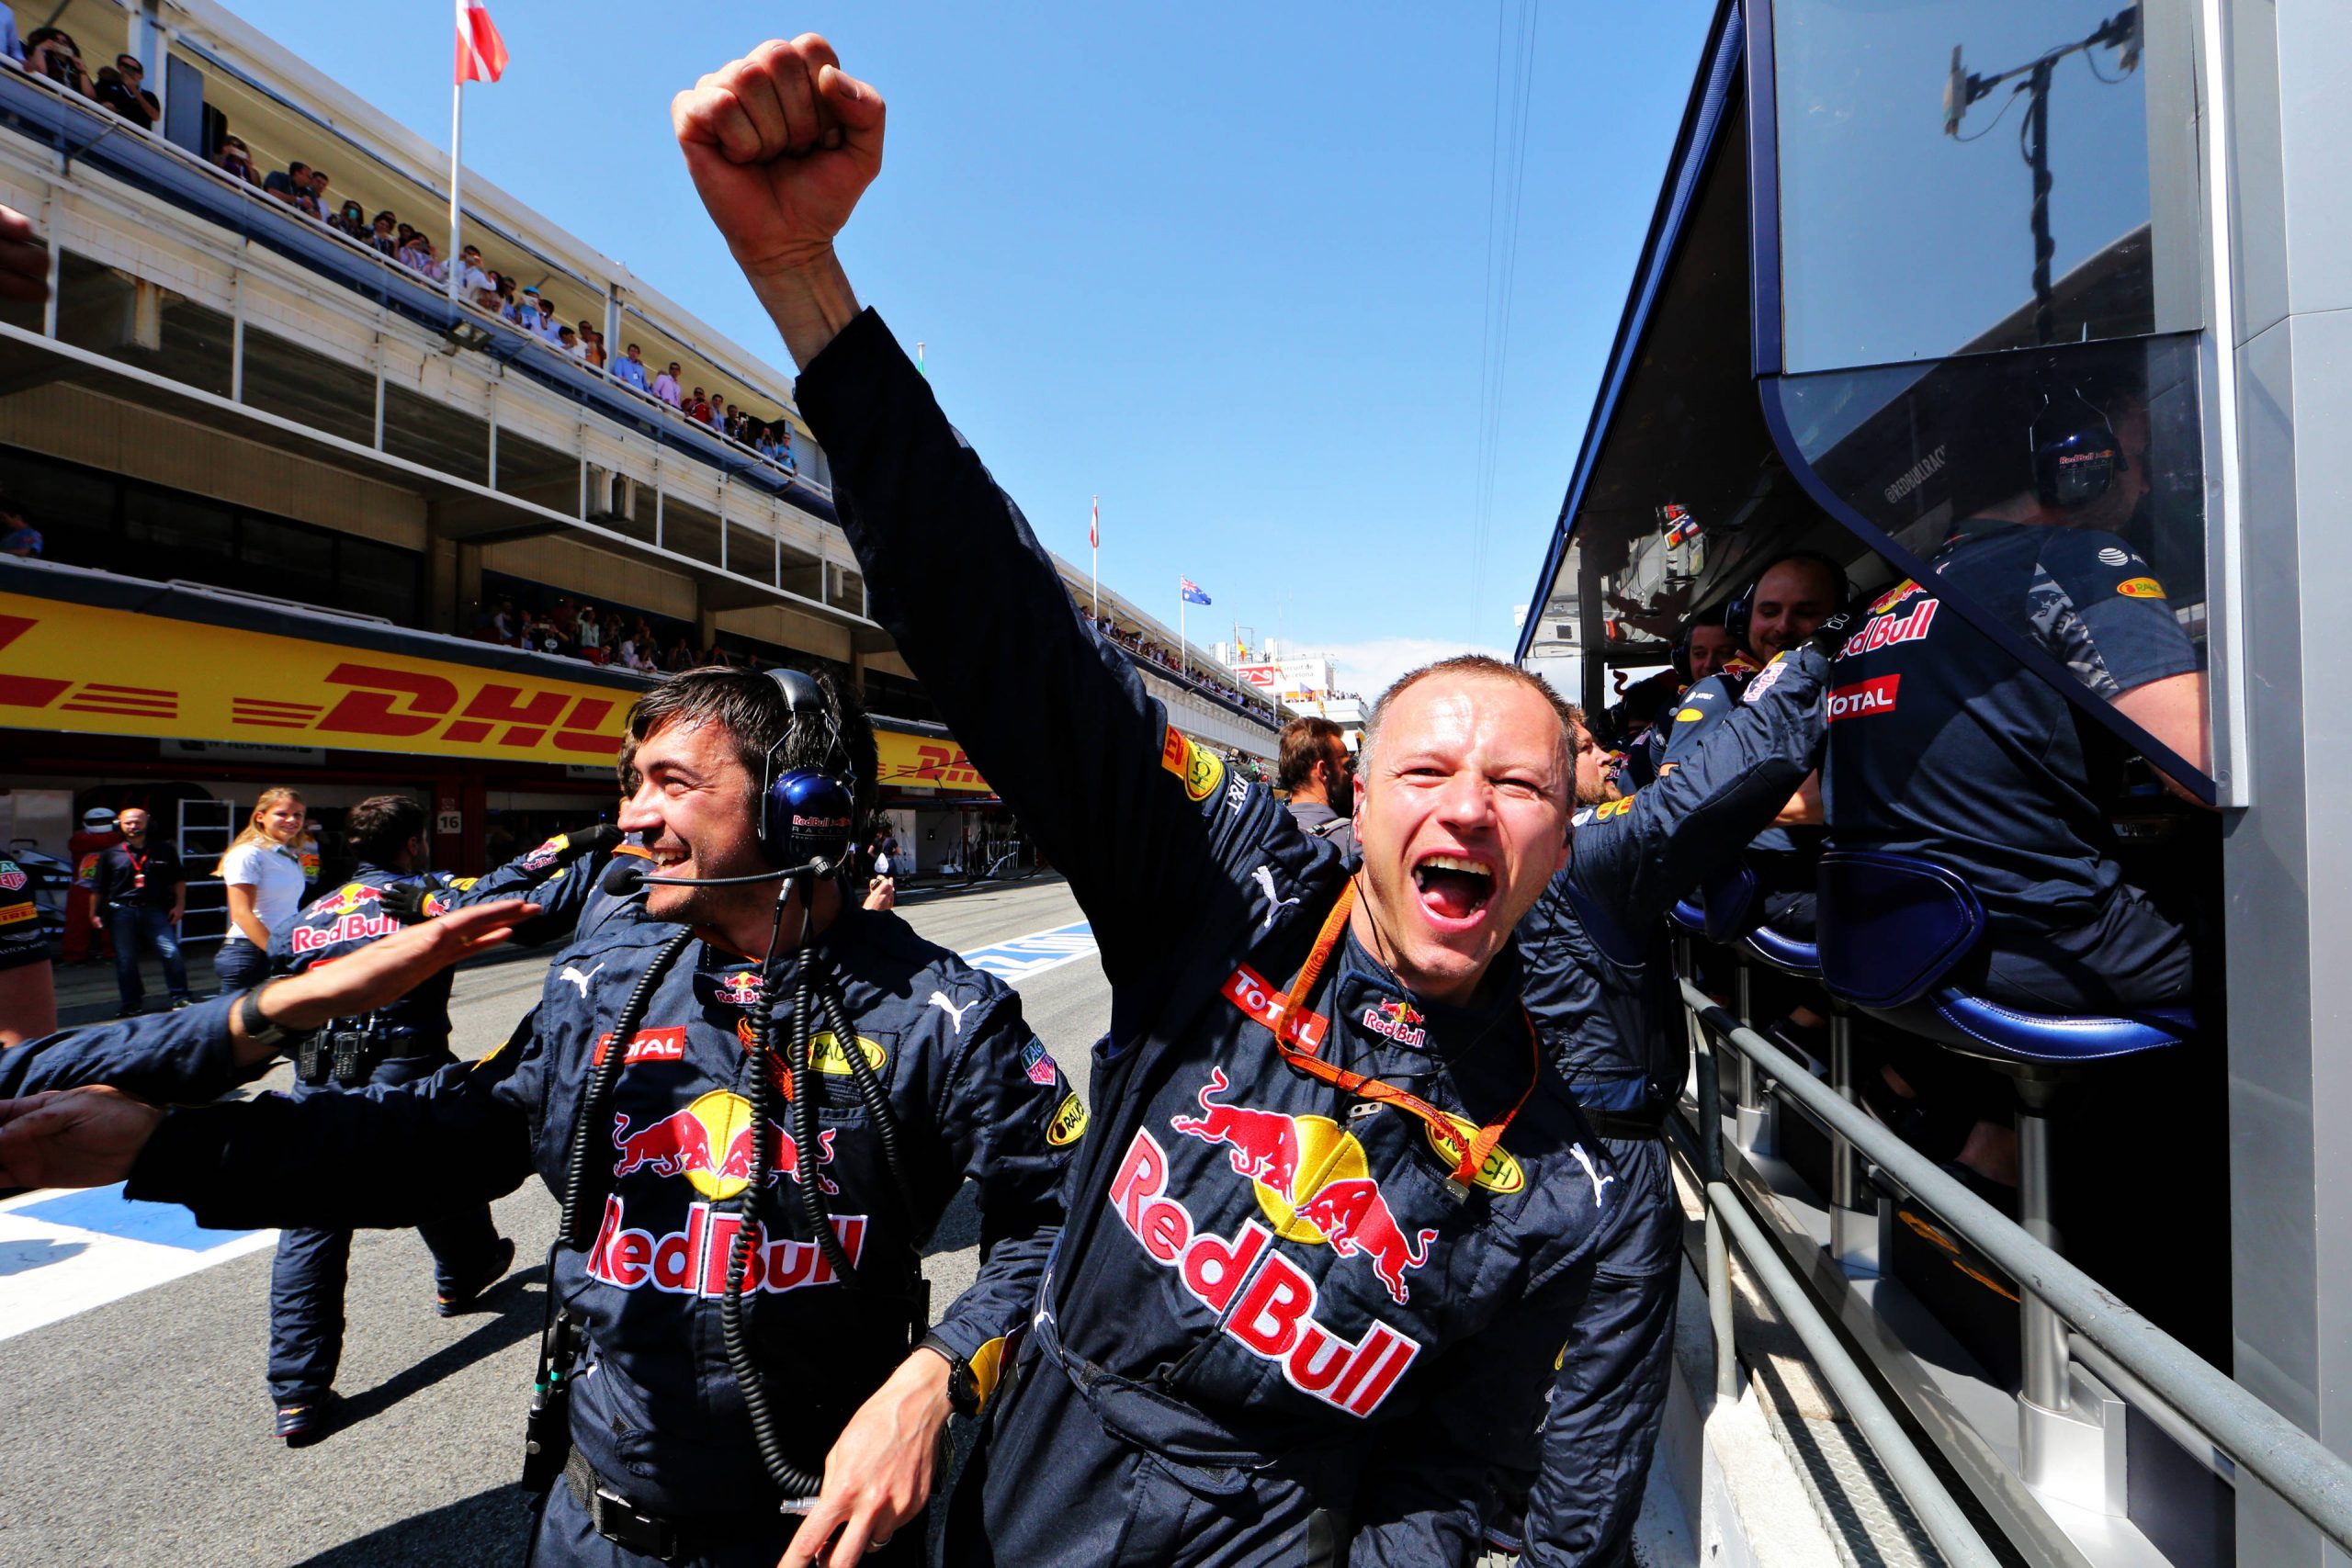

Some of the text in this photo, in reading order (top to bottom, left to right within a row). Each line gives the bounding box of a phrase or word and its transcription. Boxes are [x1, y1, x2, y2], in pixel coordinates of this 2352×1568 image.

[1865, 598, 1939, 653] Bull
[315, 662, 627, 755] DHL
[440, 816, 458, 829] 16
[0, 862, 21, 873] AG
[292, 912, 400, 954] Red Bull
[714, 987, 742, 1005] Red
[1363, 1008, 1426, 1048] Red Bull
[812, 1042, 875, 1066] RAUH
[1024, 1042, 1044, 1066] TAG
[585, 1193, 869, 1299] Red Bull
[1108, 1124, 1421, 1418] Red Bull
